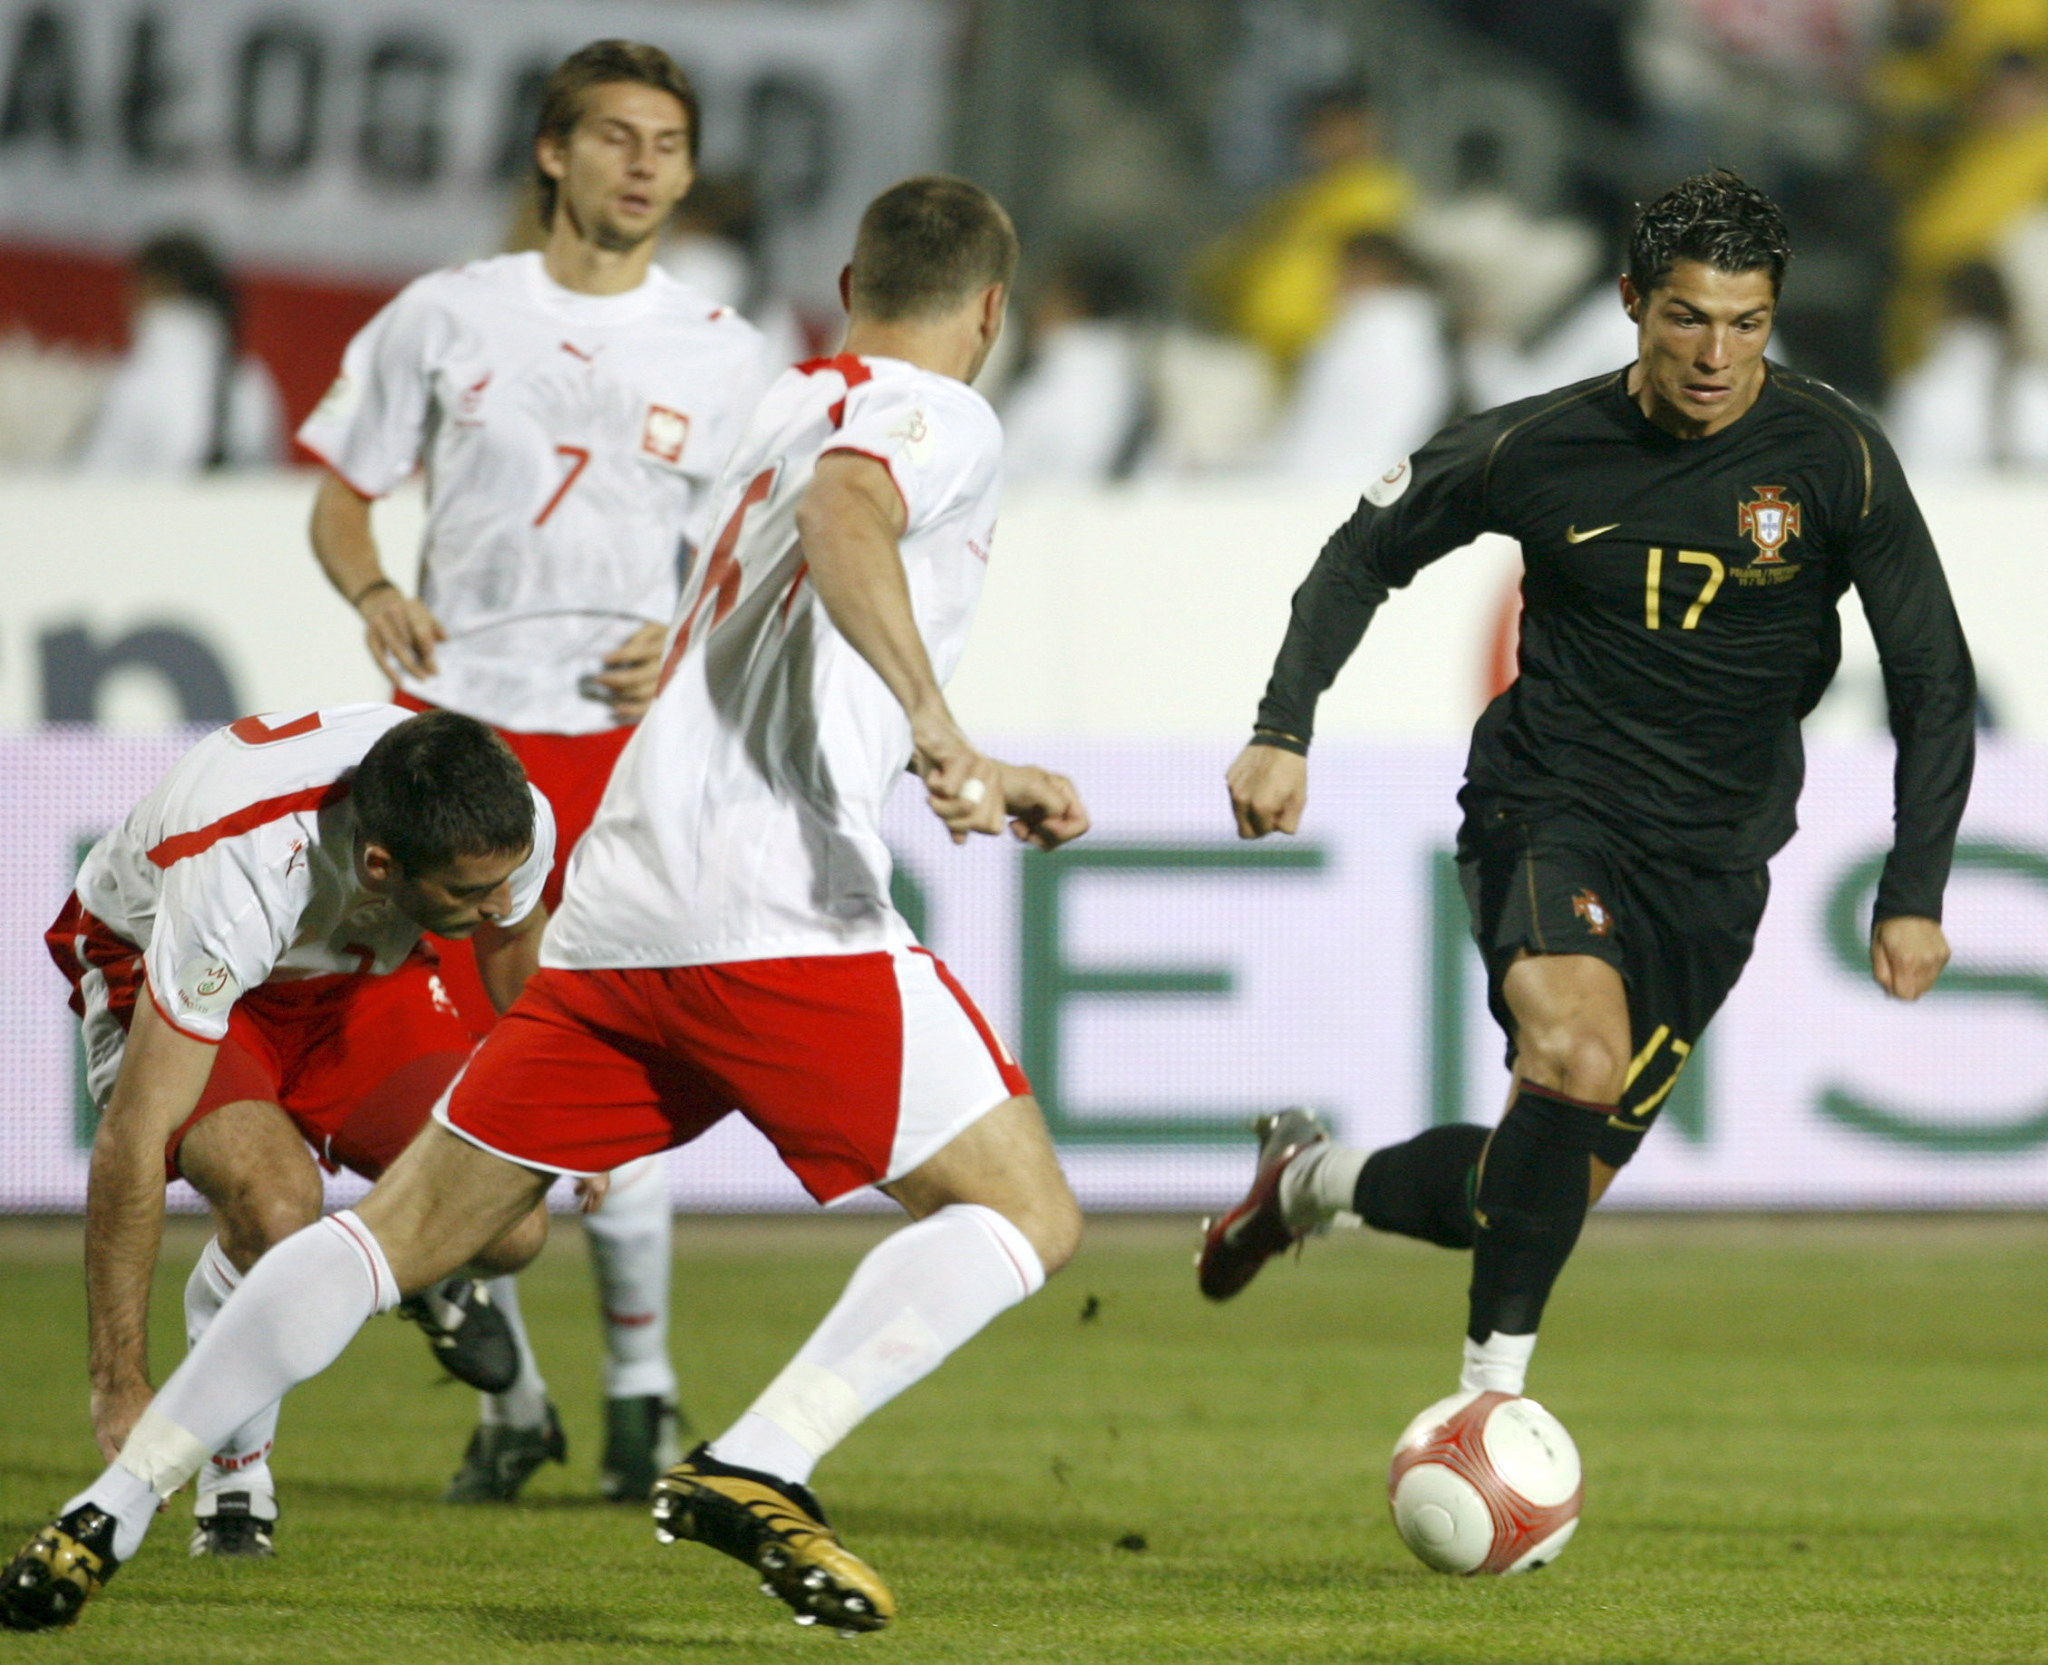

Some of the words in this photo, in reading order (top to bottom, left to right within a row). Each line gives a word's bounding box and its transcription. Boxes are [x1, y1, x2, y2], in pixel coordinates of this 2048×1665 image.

[534, 444, 590, 528] 7
[1645, 547, 1725, 630] 17
[1623, 1023, 1690, 1118] 17
